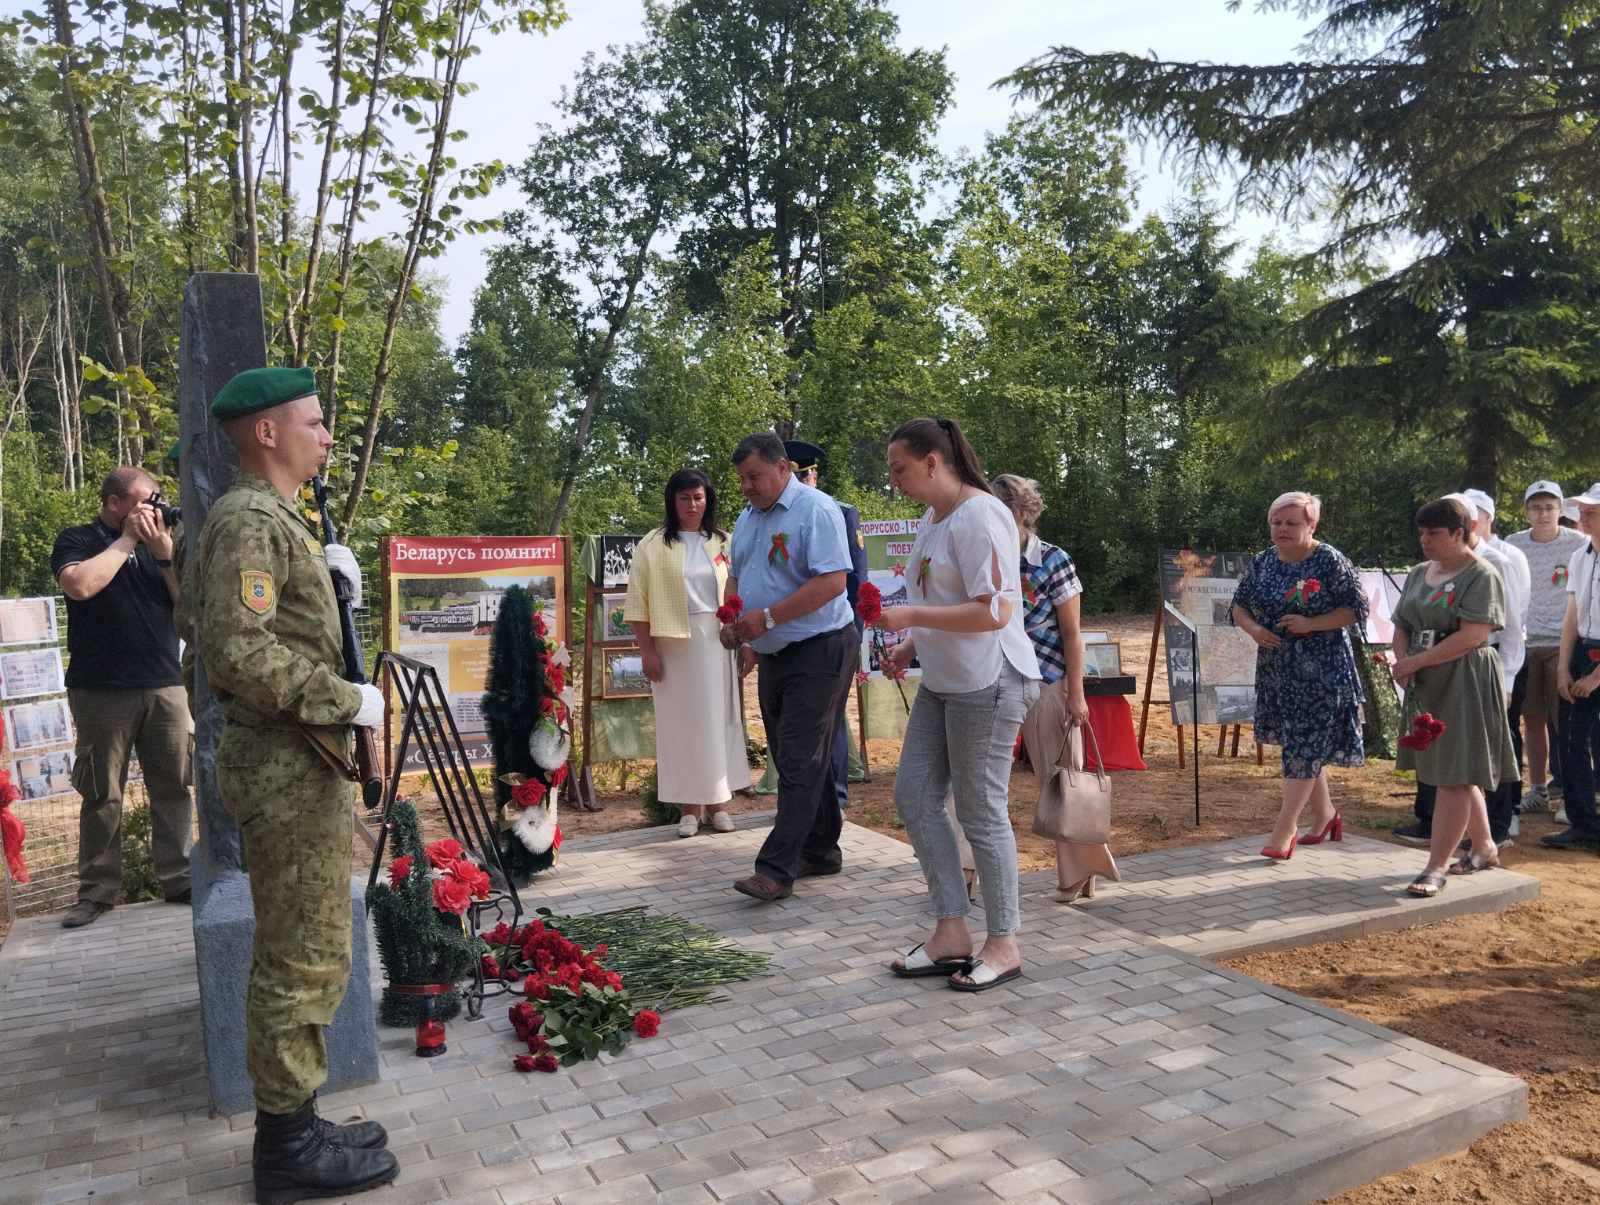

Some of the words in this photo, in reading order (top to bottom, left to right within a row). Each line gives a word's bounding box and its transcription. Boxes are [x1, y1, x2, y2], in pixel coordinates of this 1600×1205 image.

[863, 522, 900, 534] ОРУССКО
[396, 543, 476, 565] Беларусь
[481, 542, 556, 560] помнит!
[888, 543, 913, 555] "ПОЕЗ
